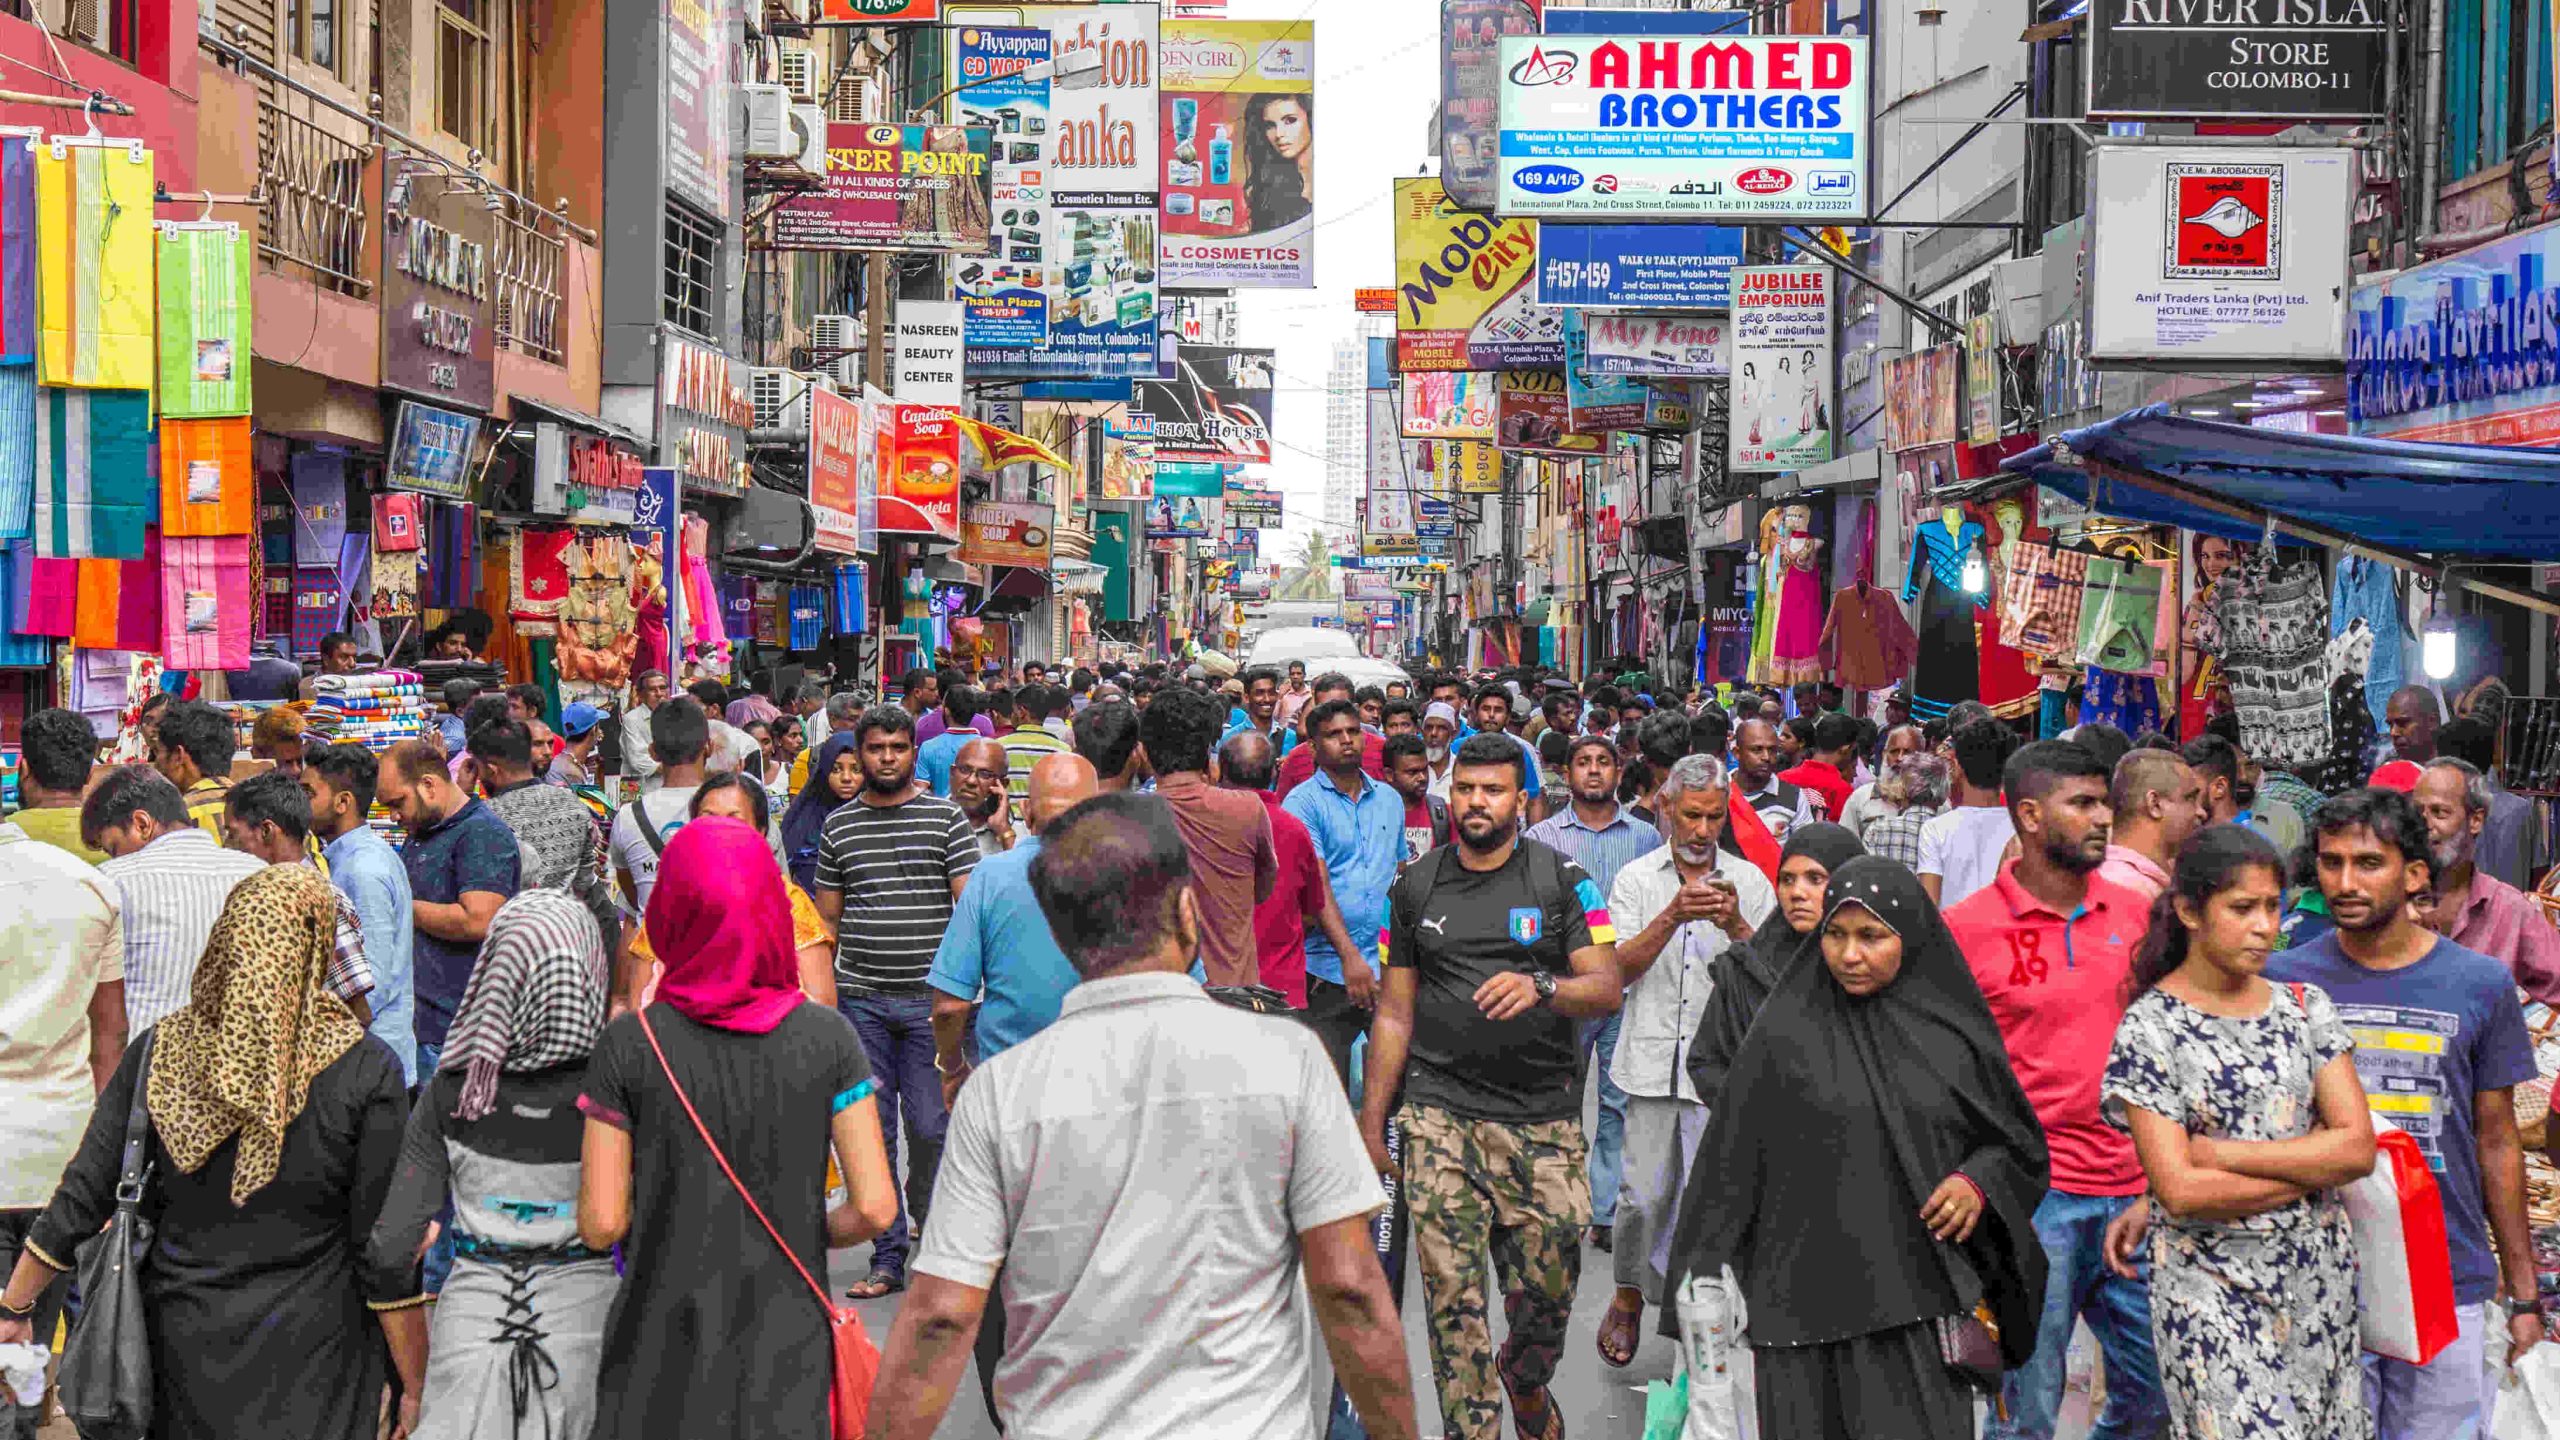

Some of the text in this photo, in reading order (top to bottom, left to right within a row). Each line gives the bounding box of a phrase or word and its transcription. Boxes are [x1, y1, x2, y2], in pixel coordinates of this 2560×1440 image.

[2121, 0, 2259, 24] RIVER
[979, 31, 1047, 54] Ayyappan
[2230, 38, 2329, 66] STORE
[1197, 51, 1238, 67] GIRL
[1588, 40, 1852, 90] AHMED
[964, 57, 985, 75] CD
[2208, 71, 2351, 89] COLOMBO-11
[1600, 93, 1841, 129] BROTHERS
[1051, 102, 1137, 169] anka
[1557, 133, 1564, 142] &
[1662, 133, 1671, 142] of
[901, 151, 986, 175] POINT
[2211, 167, 2270, 175] ABOOBACKER
[832, 177, 843, 187] IN
[845, 177, 863, 187] ALL
[864, 178, 894, 188] KINDS
[896, 178, 911, 188] OF
[914, 179, 951, 189] SAREES
[1517, 172, 1580, 185] 169 A/1/5
[842, 189, 918, 201] (WHOLESALE ONLY)
[994, 190, 1017, 199] JVC
[1057, 193, 1153, 204] Cosmetics Items Etc.
[1511, 199, 1564, 209] International
[1593, 200, 1608, 209] 2nd
[1610, 201, 1634, 209] Cross
[1665, 201, 1700, 209] Colombo
[1735, 201, 1750, 210] 011
[1797, 202, 1812, 210] 072
[1815, 202, 1852, 210] 2323221
[1181, 246, 1300, 260] COSMETICS
[1216, 262, 1251, 270] Cosmetics
[1618, 255, 1644, 266] WALK
[1653, 255, 1677, 266] TALK
[1678, 255, 1702, 267] (PVT)
[1704, 256, 1739, 267] LIMITED
[1546, 258, 1611, 289] #157-159
[1636, 269, 1654, 279] First
[1681, 270, 1707, 279] Mobile
[1622, 281, 1638, 290] 2nd
[1639, 281, 1660, 290] Cross
[1689, 281, 1723, 290] Colombo
[1740, 272, 1823, 291] JUBILEE
[961, 296, 1042, 307] Thaika Plaza
[1675, 293, 1690, 301] Fax
[1738, 293, 1825, 308] EMPORIUM
[2135, 293, 2309, 305] Anif Traders Lanka (Pvt) Ltd.
[2157, 306, 2286, 317] HOTLINE: 07777 56126
[901, 324, 959, 337] NASREEN
[1594, 317, 1721, 350] My Fone
[1056, 333, 1076, 346] Cross
[904, 348, 954, 360] BEAUTY
[1414, 349, 1454, 358] MOBILE
[1502, 345, 1533, 354] Mumbai
[967, 350, 1126, 366] 2441936 Email: fashonlanka@gmail.com
[1400, 360, 1468, 369] ACCESSORIES
[1504, 353, 1551, 363] Colombo-11.
[1602, 358, 1634, 372] 157/10,
[904, 371, 954, 384] CENTER
[914, 421, 943, 436] Soap
[1203, 419, 1265, 440] HOUSE
[1408, 421, 1432, 430] 144
[982, 526, 1010, 542] SOAP
[642, 862, 658, 873] M
